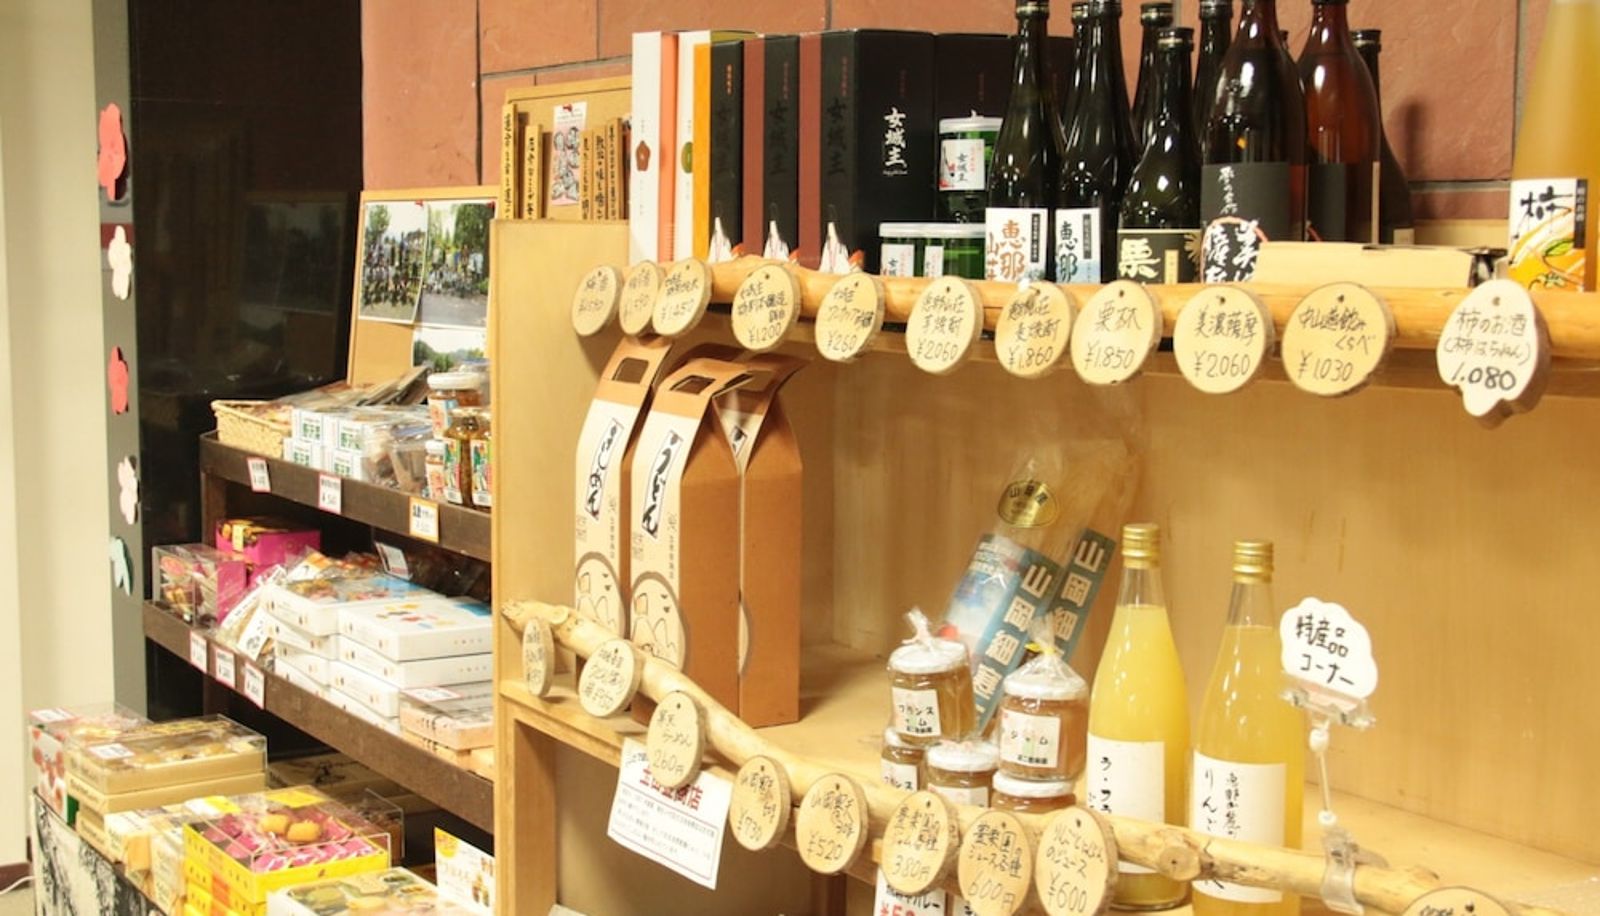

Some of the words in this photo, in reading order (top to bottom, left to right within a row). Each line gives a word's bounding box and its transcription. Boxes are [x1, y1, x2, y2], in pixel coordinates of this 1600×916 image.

[882, 107, 908, 169] 女城主
[1119, 238, 1161, 278] 栗
[1457, 307, 1528, 337] 柿のお酒
[1450, 360, 1517, 392] 1.080
[1296, 614, 1349, 658] 特産品
[1300, 653, 1356, 686] コーナー
[892, 854, 929, 882] 380円
[968, 870, 1015, 913] 600円
[1047, 870, 1087, 914] ¥600
